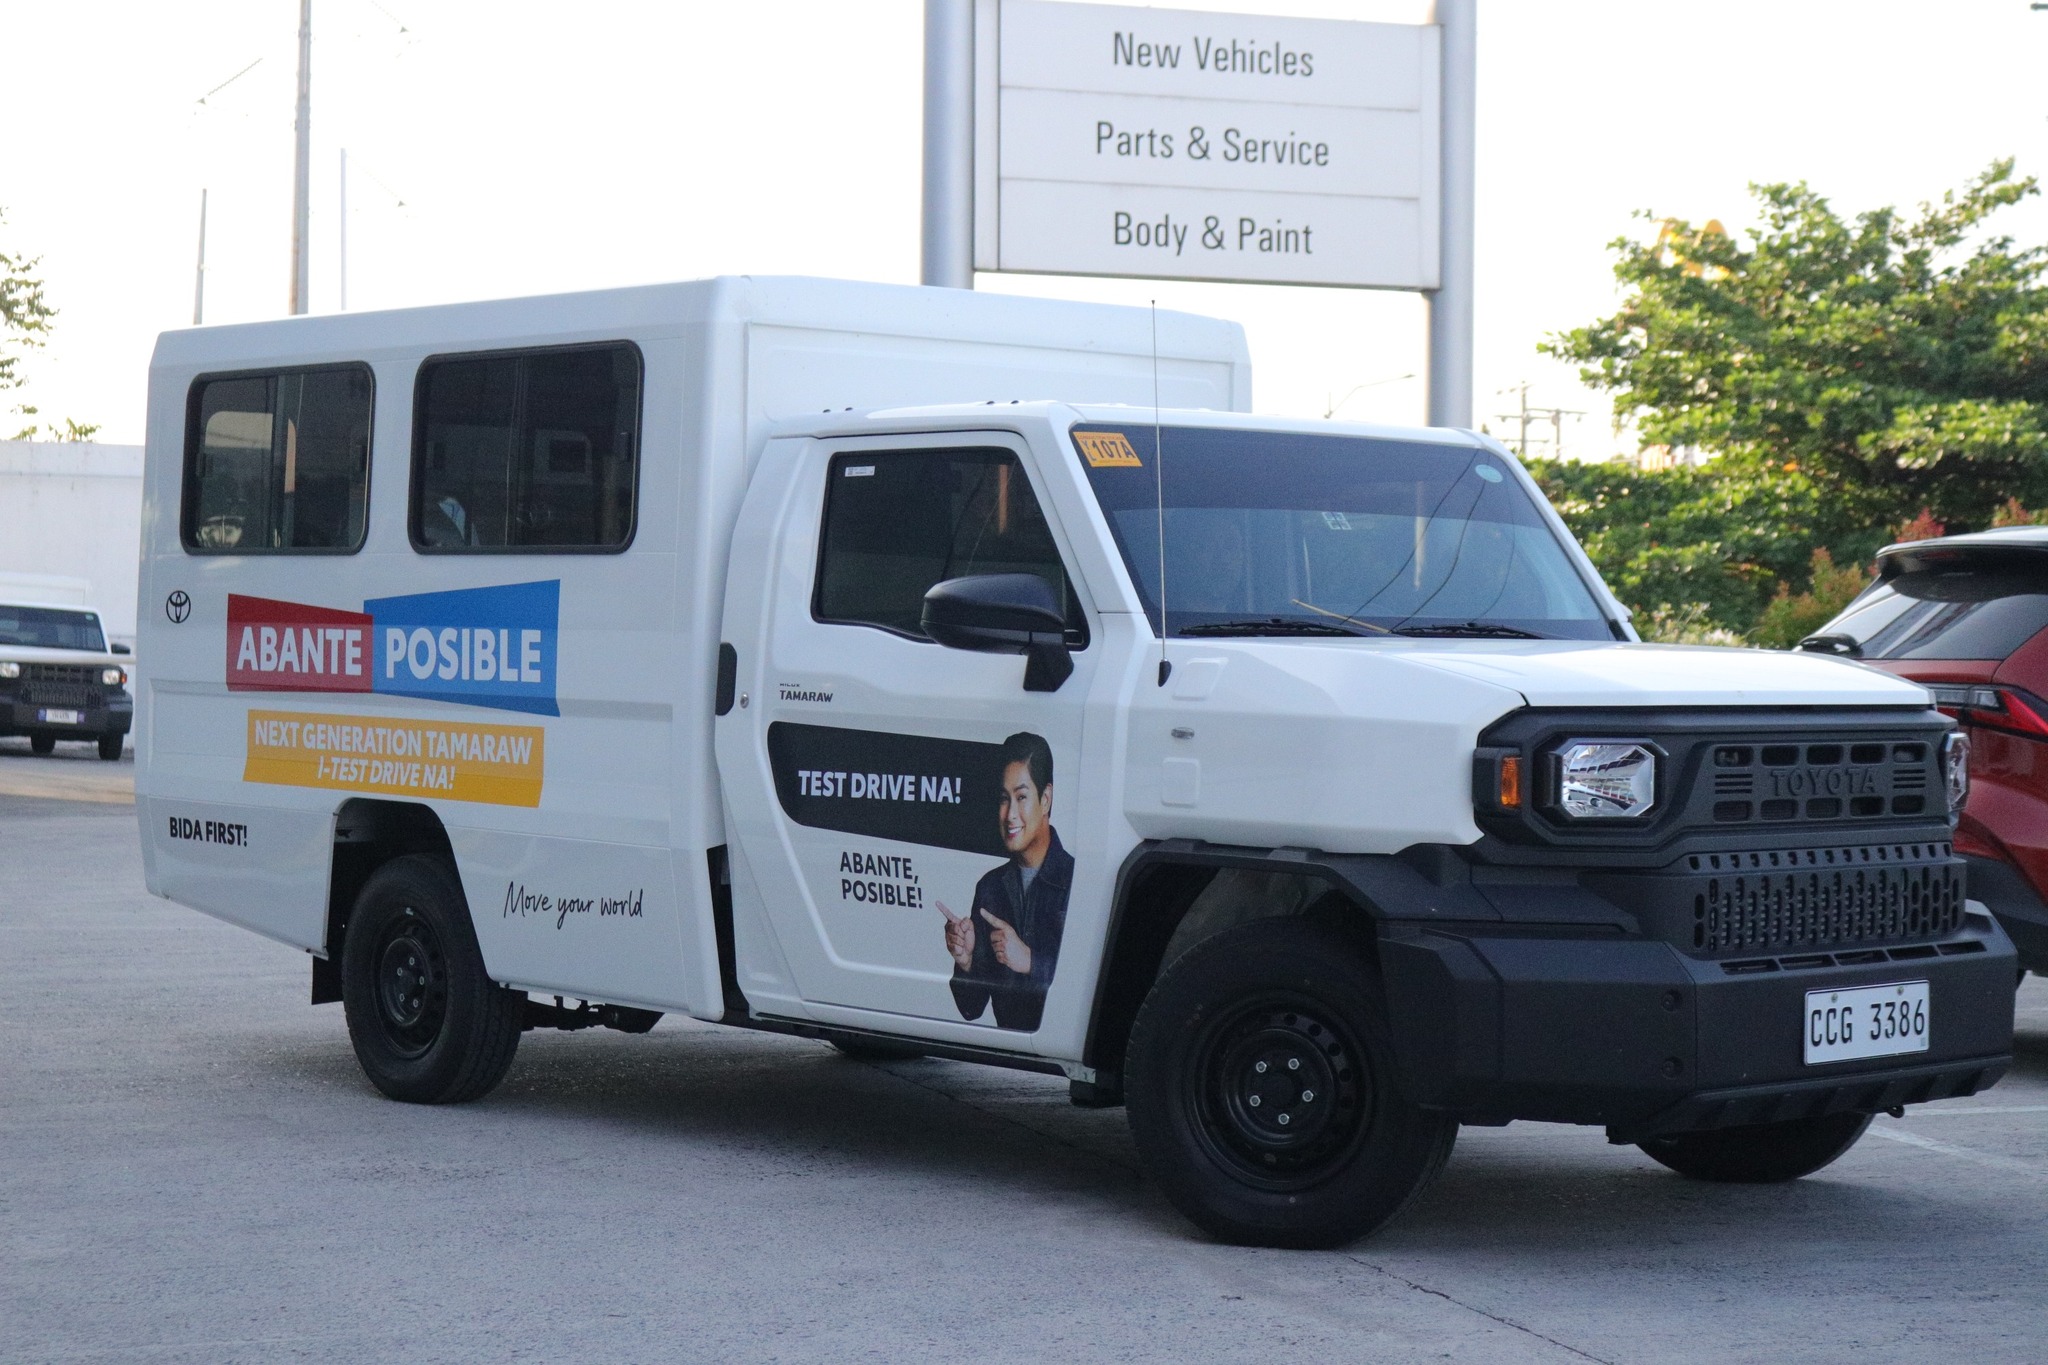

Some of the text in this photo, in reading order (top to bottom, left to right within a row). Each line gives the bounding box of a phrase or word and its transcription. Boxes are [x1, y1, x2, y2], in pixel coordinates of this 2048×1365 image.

[1112, 32, 1314, 78] New Vehicles
[1096, 121, 1330, 167] Parts & Service
[1114, 211, 1313, 256] Body & Paint
[236, 626, 542, 683] ABANTE POSIBLE
[780, 690, 833, 702] TAMARAW
[255, 719, 533, 765] NEXT GENERATION TAMARAW
[370, 761, 422, 787] DRIVE
[421, 764, 456, 790] NA!
[798, 770, 962, 804] TEST DRIVE NA!
[1771, 768, 1877, 797] TOYOTA
[169, 816, 248, 848] BIDA FIRST!
[840, 852, 919, 884] ABANTE,
[503, 881, 644, 930] Move your world
[841, 879, 923, 909] POSIBLE!
[1811, 999, 1925, 1047] CCG 3386
